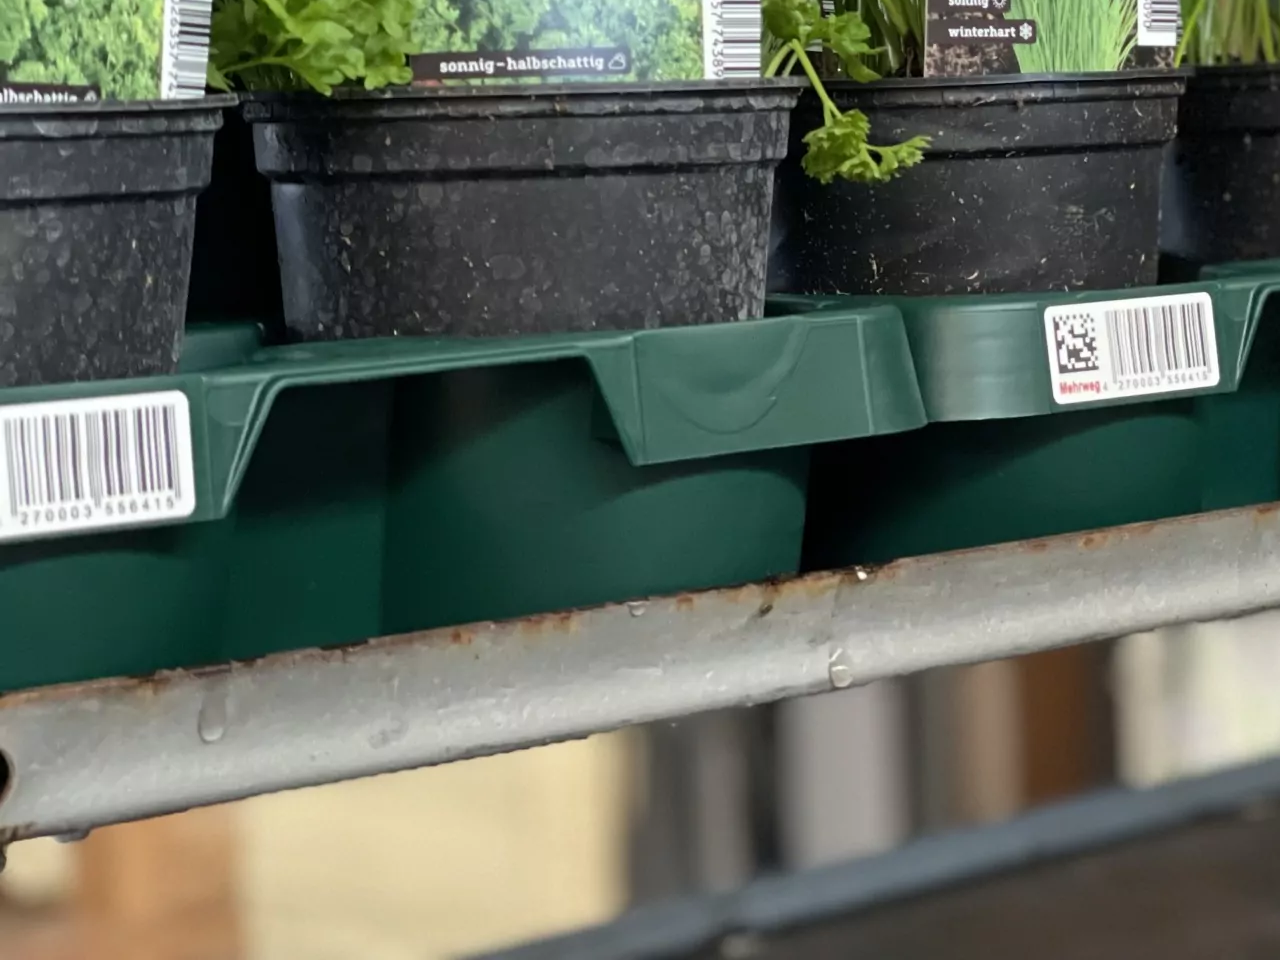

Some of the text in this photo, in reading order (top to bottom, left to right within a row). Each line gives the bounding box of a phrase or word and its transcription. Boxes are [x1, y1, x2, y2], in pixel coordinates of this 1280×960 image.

[948, 24, 1016, 38] winterhart
[1060, 380, 1101, 396] Mehrweg
[20, 505, 92, 526] 270003
